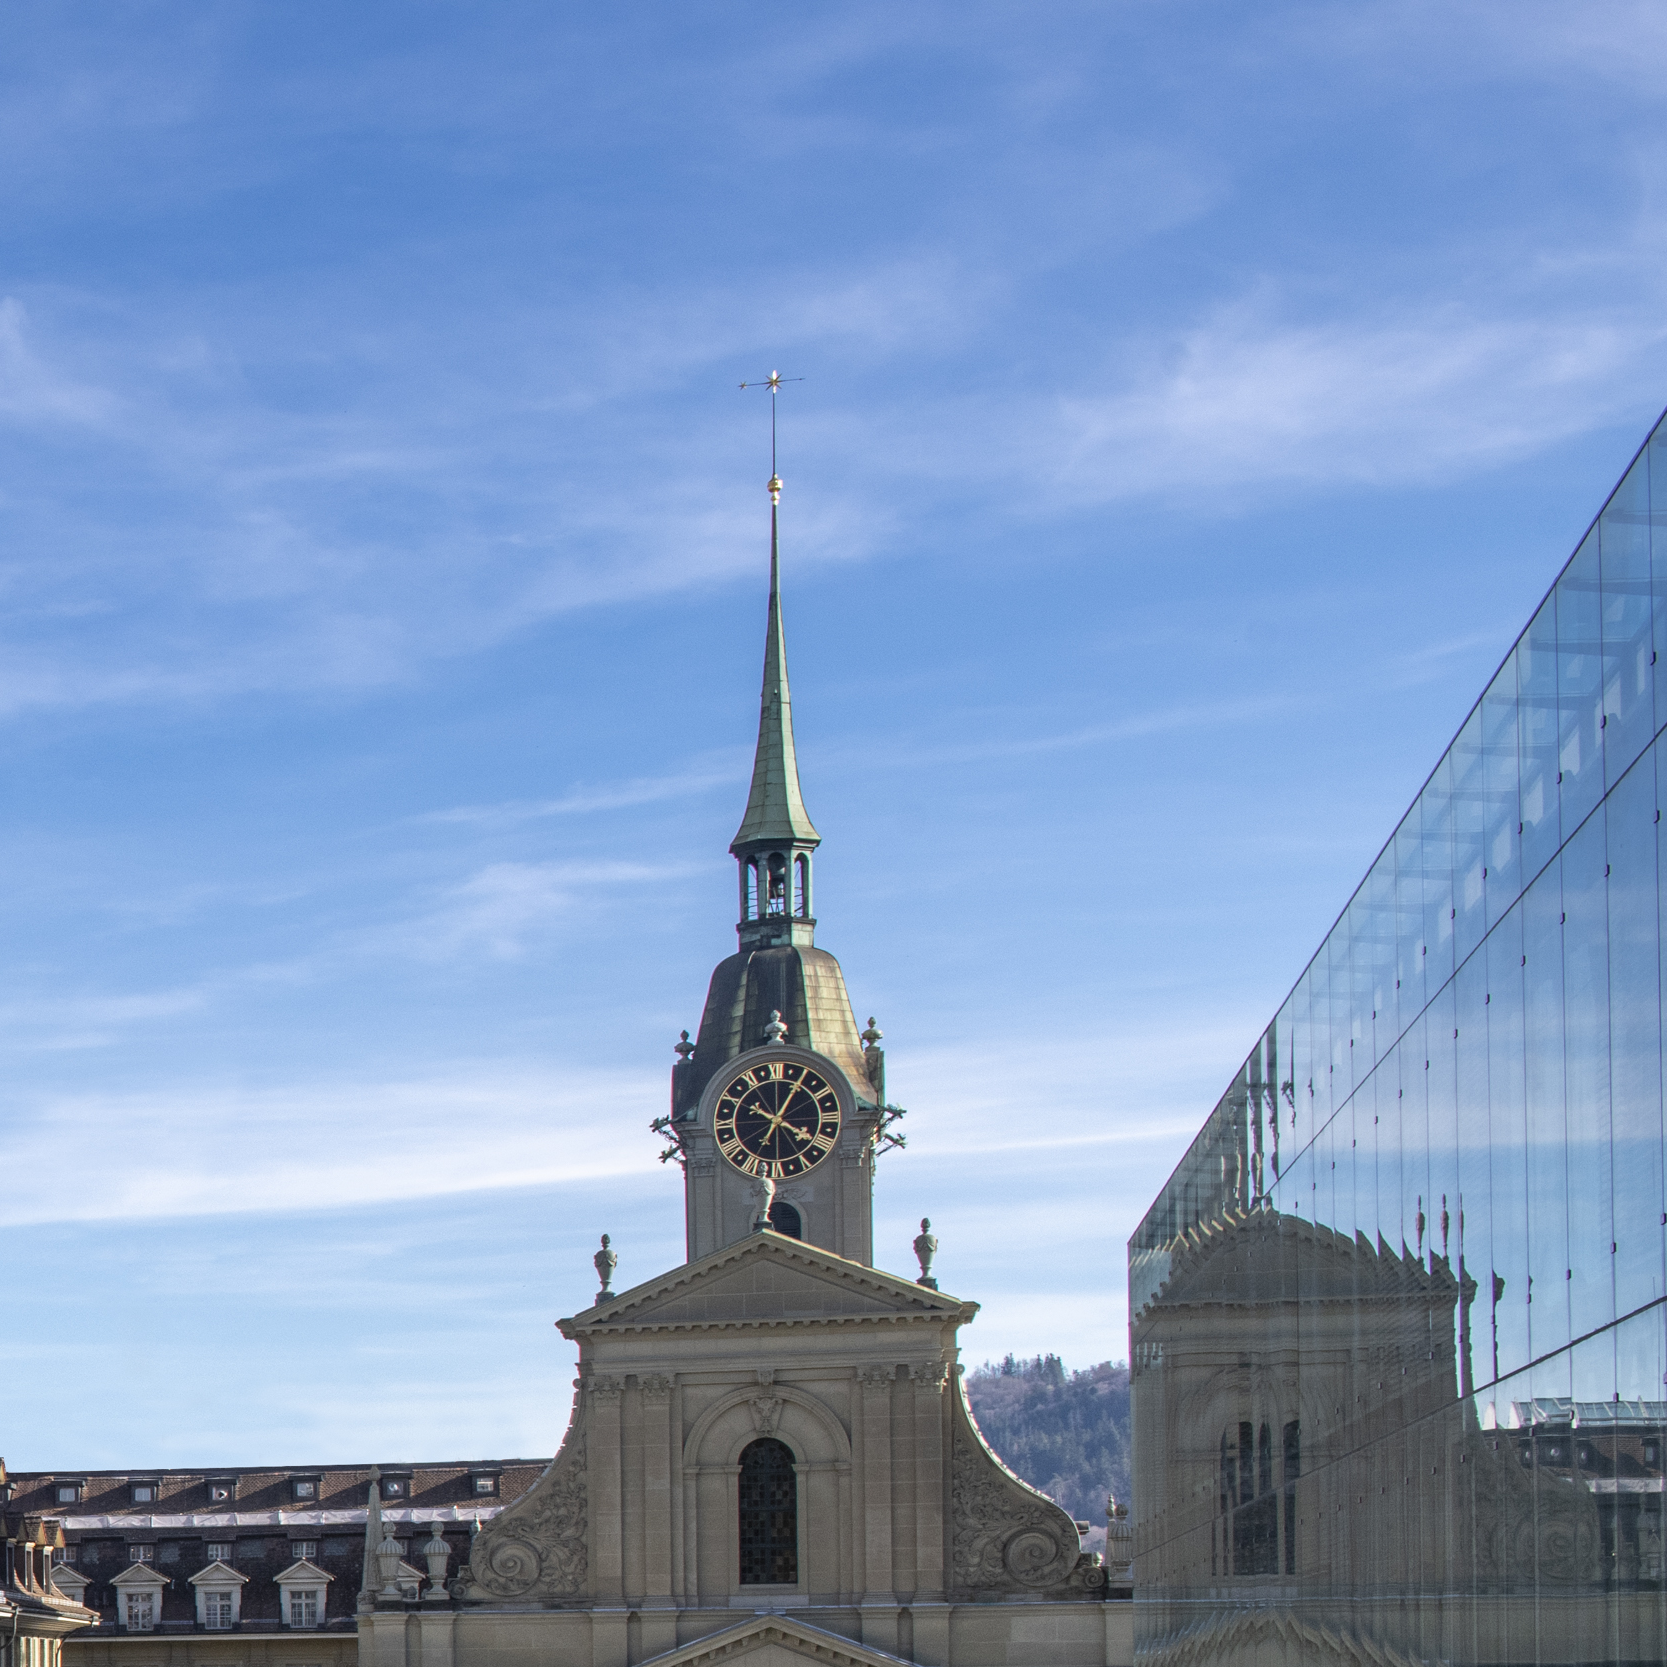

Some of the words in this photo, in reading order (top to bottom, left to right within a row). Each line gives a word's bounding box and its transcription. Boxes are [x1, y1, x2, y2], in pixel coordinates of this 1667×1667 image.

[742, 1071, 759, 1088] XI
[769, 1063, 784, 1080] XII
[722, 1092, 740, 1106] X
[814, 1085, 832, 1100] II
[716, 1119, 733, 1129] IX
[822, 1112, 838, 1122] III
[721, 1138, 742, 1159] VIII
[813, 1134, 834, 1152] IIII
[742, 1156, 759, 1175] VII
[771, 1162, 785, 1178] VI
[799, 1154, 812, 1171] V
